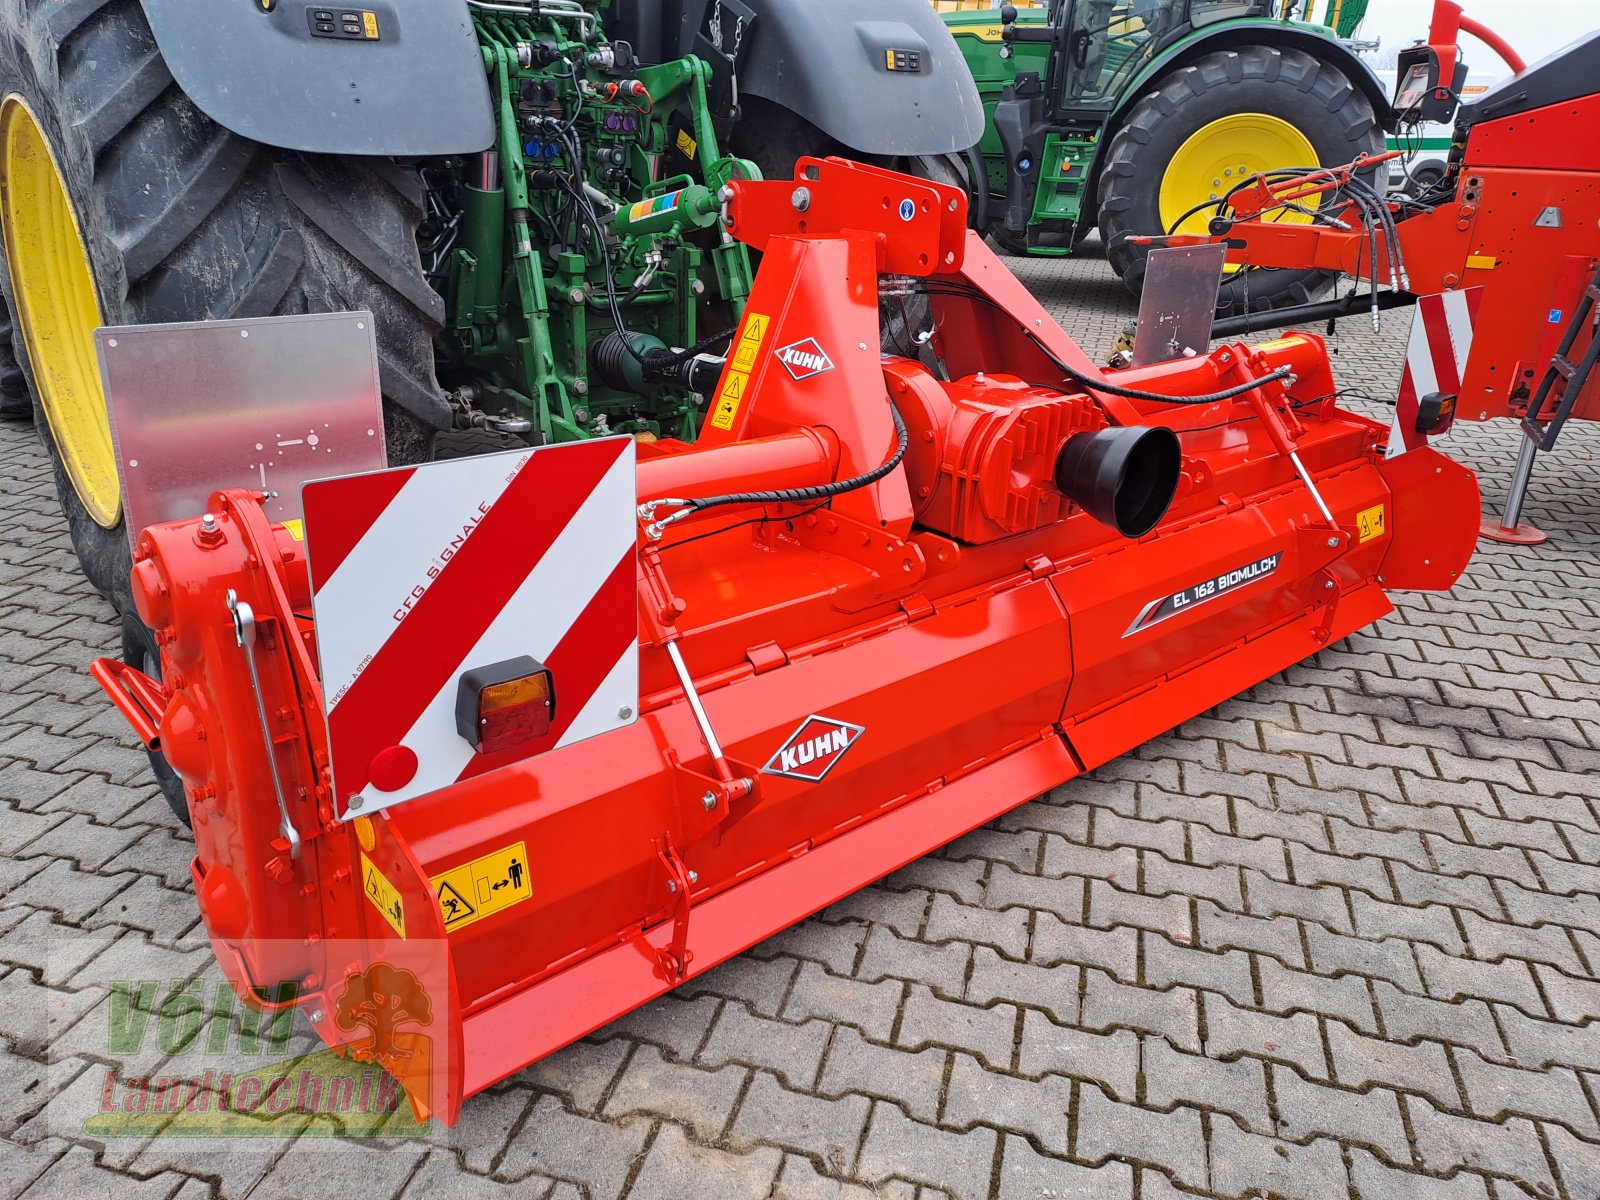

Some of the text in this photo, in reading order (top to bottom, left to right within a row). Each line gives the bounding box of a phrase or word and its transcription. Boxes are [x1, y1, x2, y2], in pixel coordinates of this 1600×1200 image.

[783, 348, 825, 371] KUHN
[505, 470, 516, 483] DIN
[393, 584, 425, 622] CFG
[1173, 555, 1277, 609] EL 162 BIOMULCH
[329, 684, 349, 706] TPESC
[356, 654, 373, 673] 07190
[780, 726, 848, 773] KUHN
